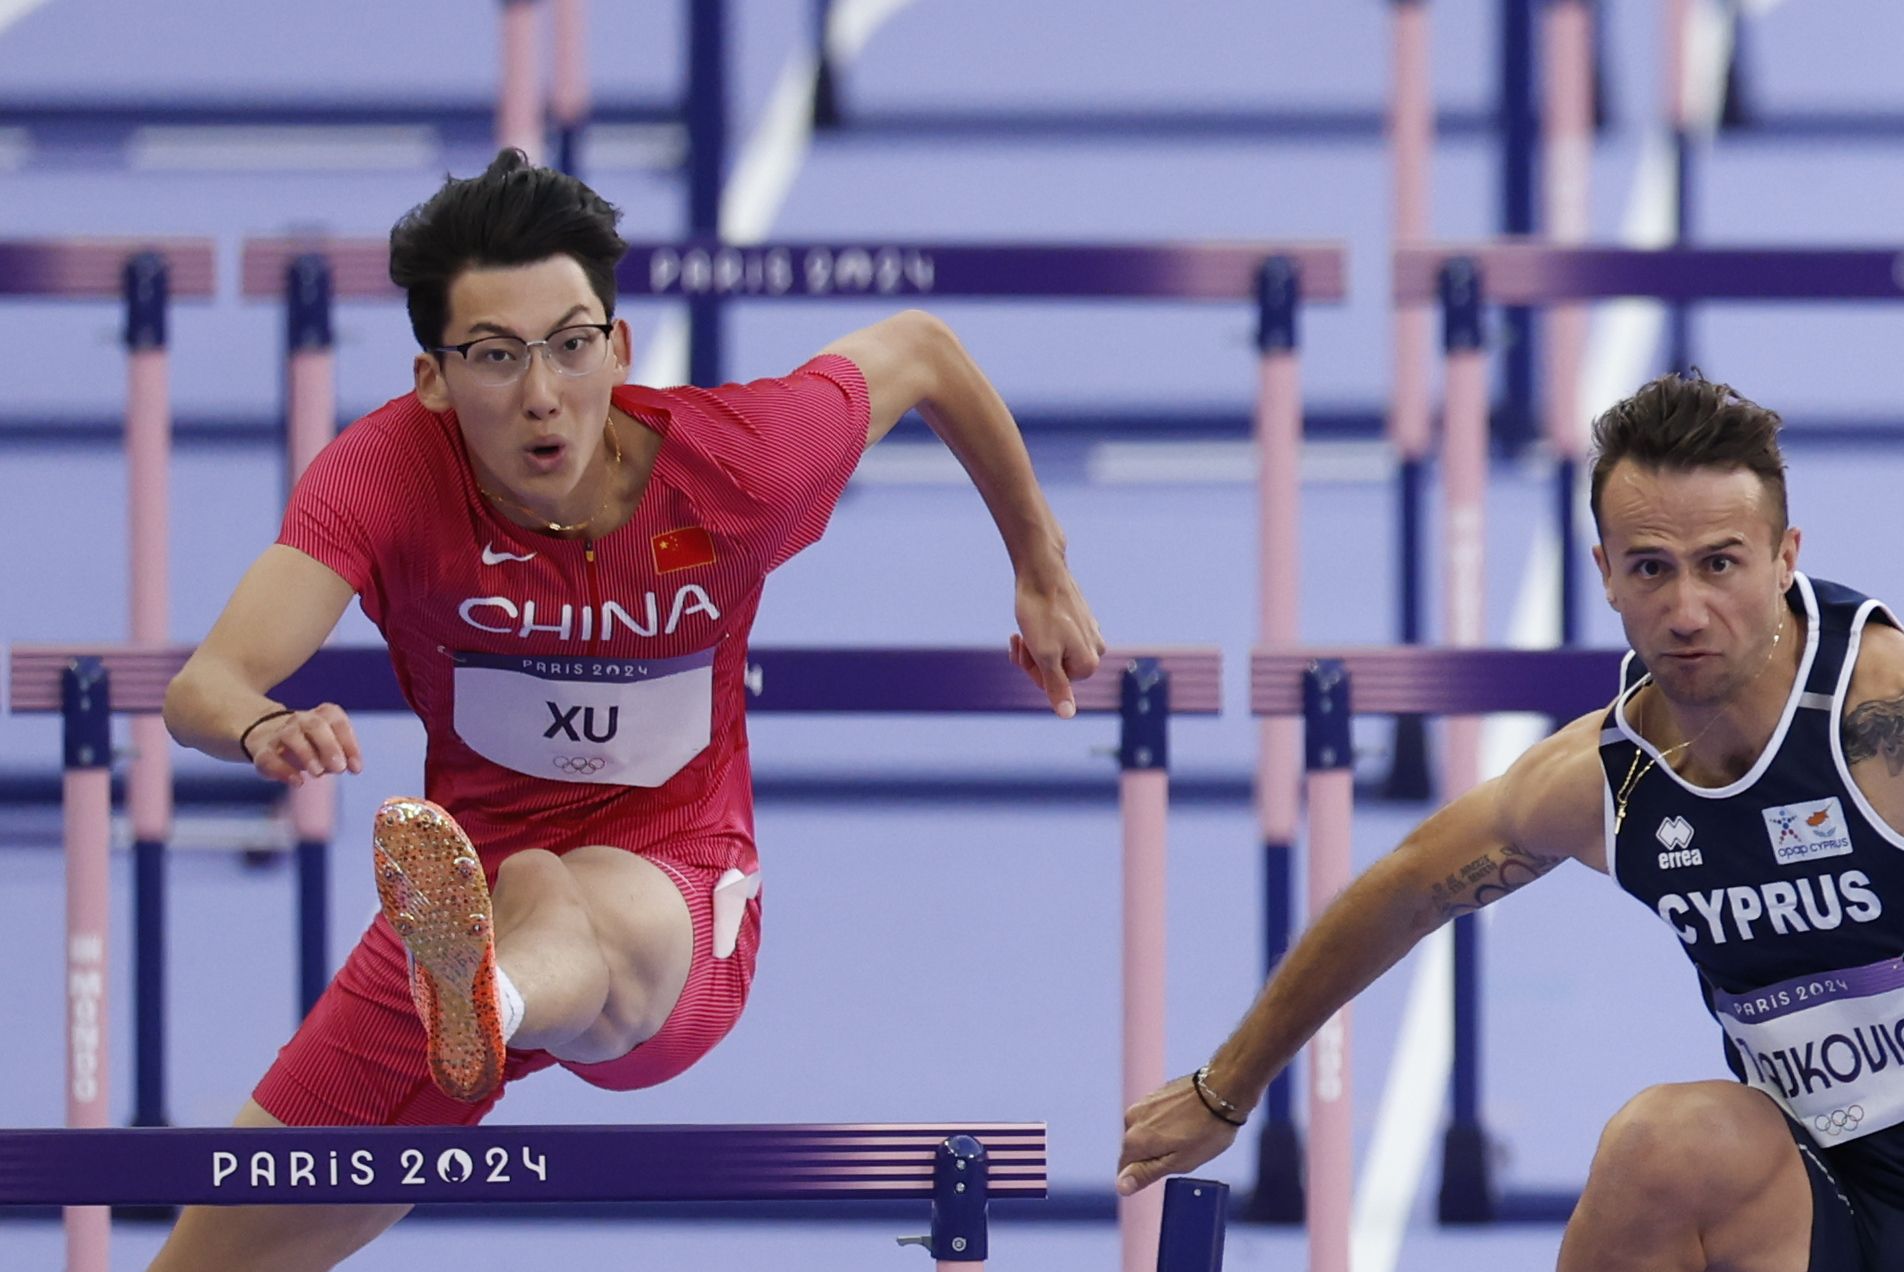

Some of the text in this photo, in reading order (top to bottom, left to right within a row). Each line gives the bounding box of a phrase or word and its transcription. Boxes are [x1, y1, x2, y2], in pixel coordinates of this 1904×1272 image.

[458, 583, 721, 641] CHINA
[522, 660, 648, 677] PARIS 2024
[543, 700, 620, 743] XU
[1777, 837, 1849, 860] opap CYPRUS
[1658, 870, 1883, 945] CYPRUS
[1733, 979, 1849, 1016] PARIS 2024
[212, 1146, 547, 1187] PARIS 2024
